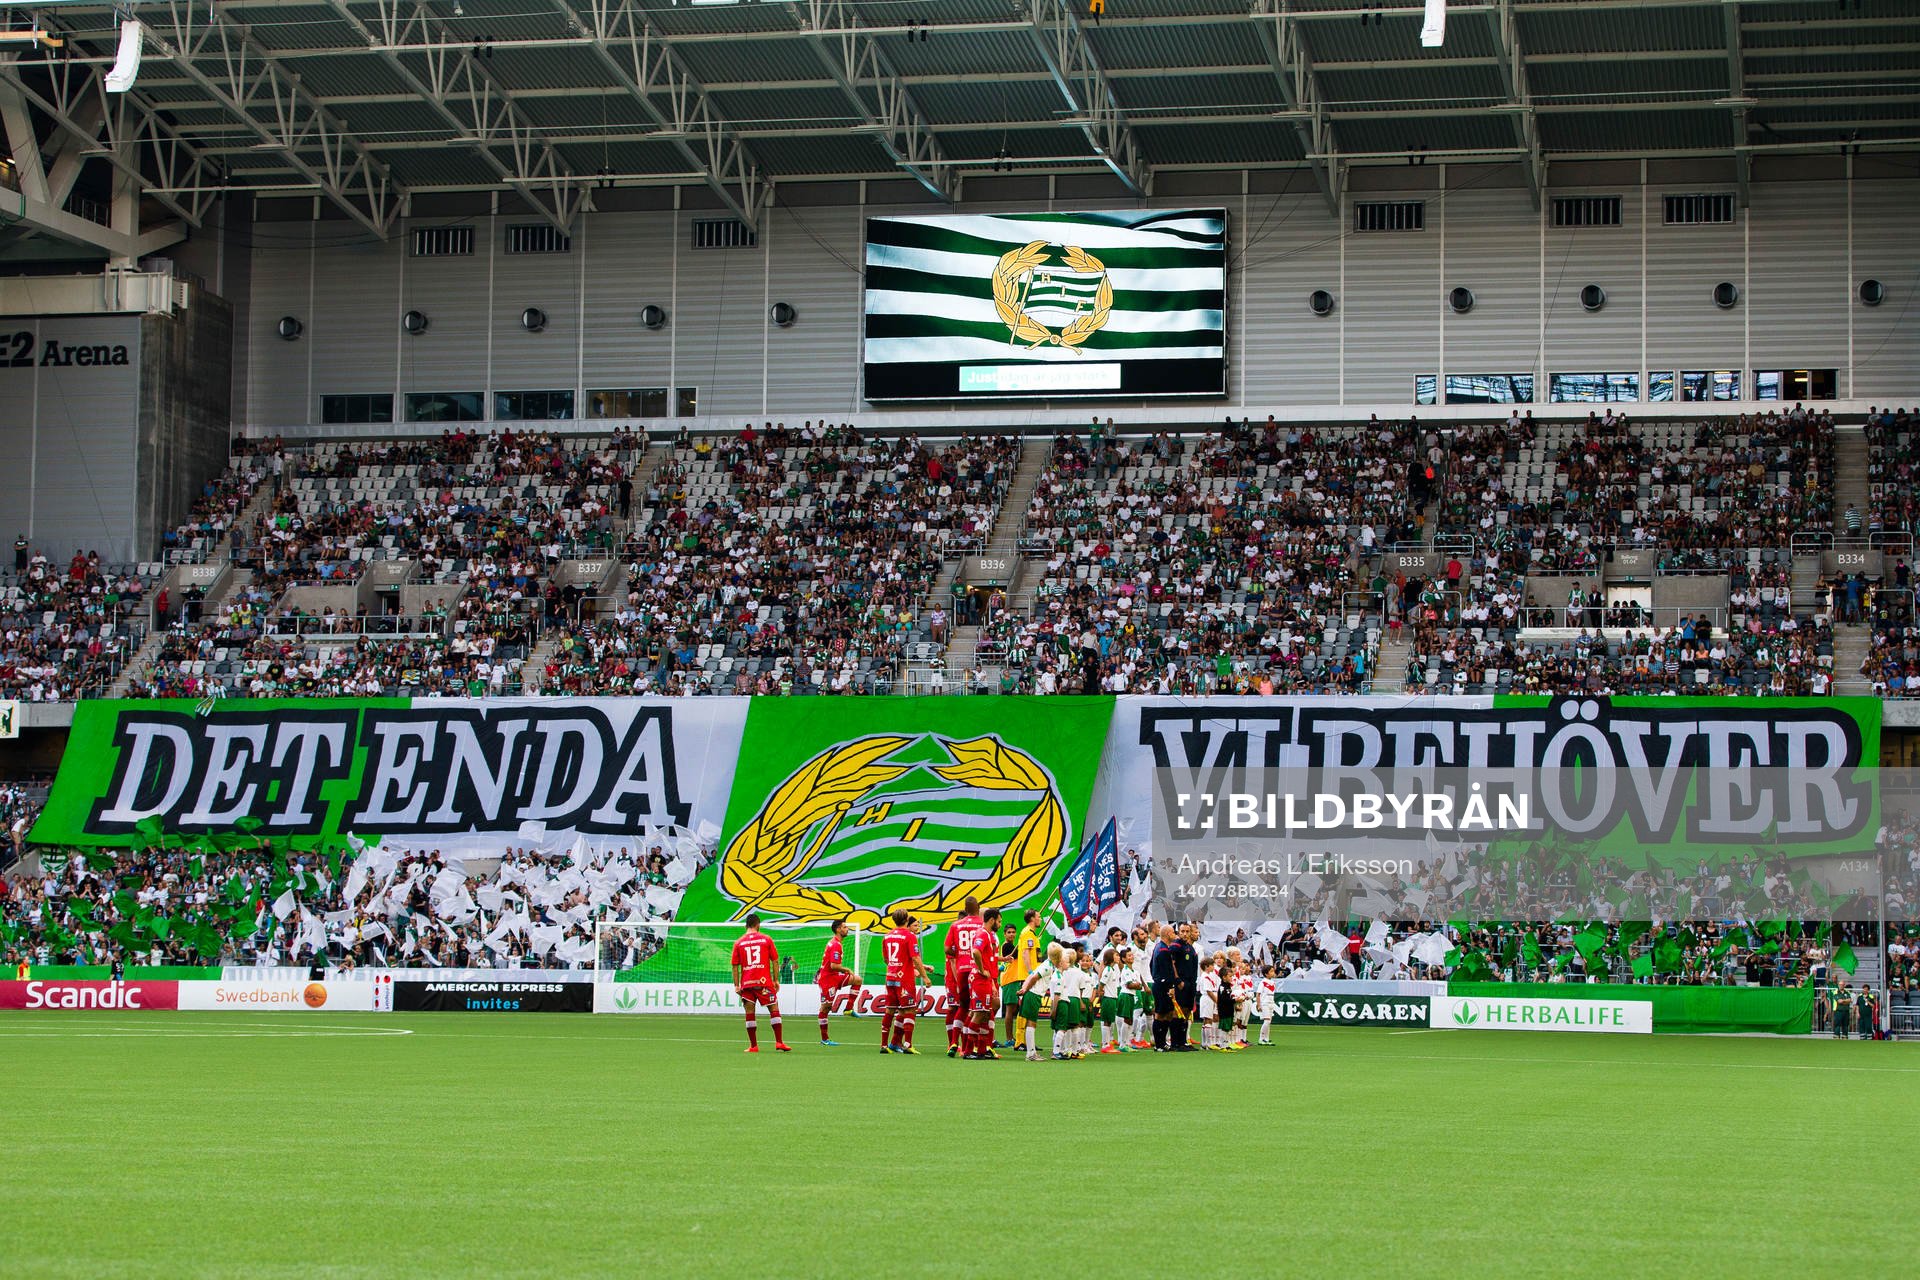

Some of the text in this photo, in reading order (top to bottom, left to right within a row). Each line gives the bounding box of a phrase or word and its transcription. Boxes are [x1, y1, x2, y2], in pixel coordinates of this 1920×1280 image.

[40, 340, 129, 366] Arena
[980, 560, 1006, 569] B336
[1399, 556, 1425, 567] B335
[1838, 554, 1865, 564] B334
[192, 568, 216, 577] B338
[578, 563, 603, 573] B337
[96, 714, 681, 829] DET ENDA
[1150, 699, 1860, 835] VI BEHÖVER
[1839, 861, 1870, 873] A134
[744, 945, 761, 966] 13
[887, 942, 900, 962] 12
[25, 981, 142, 1009] Scandic
[215, 987, 300, 1003] Swedbank
[425, 983, 564, 993] AMERICAN EXPRESS
[466, 998, 520, 1009] invites
[1306, 998, 1428, 1021] JÄGAREN
[1486, 1004, 1625, 1026] HERBALIFE
